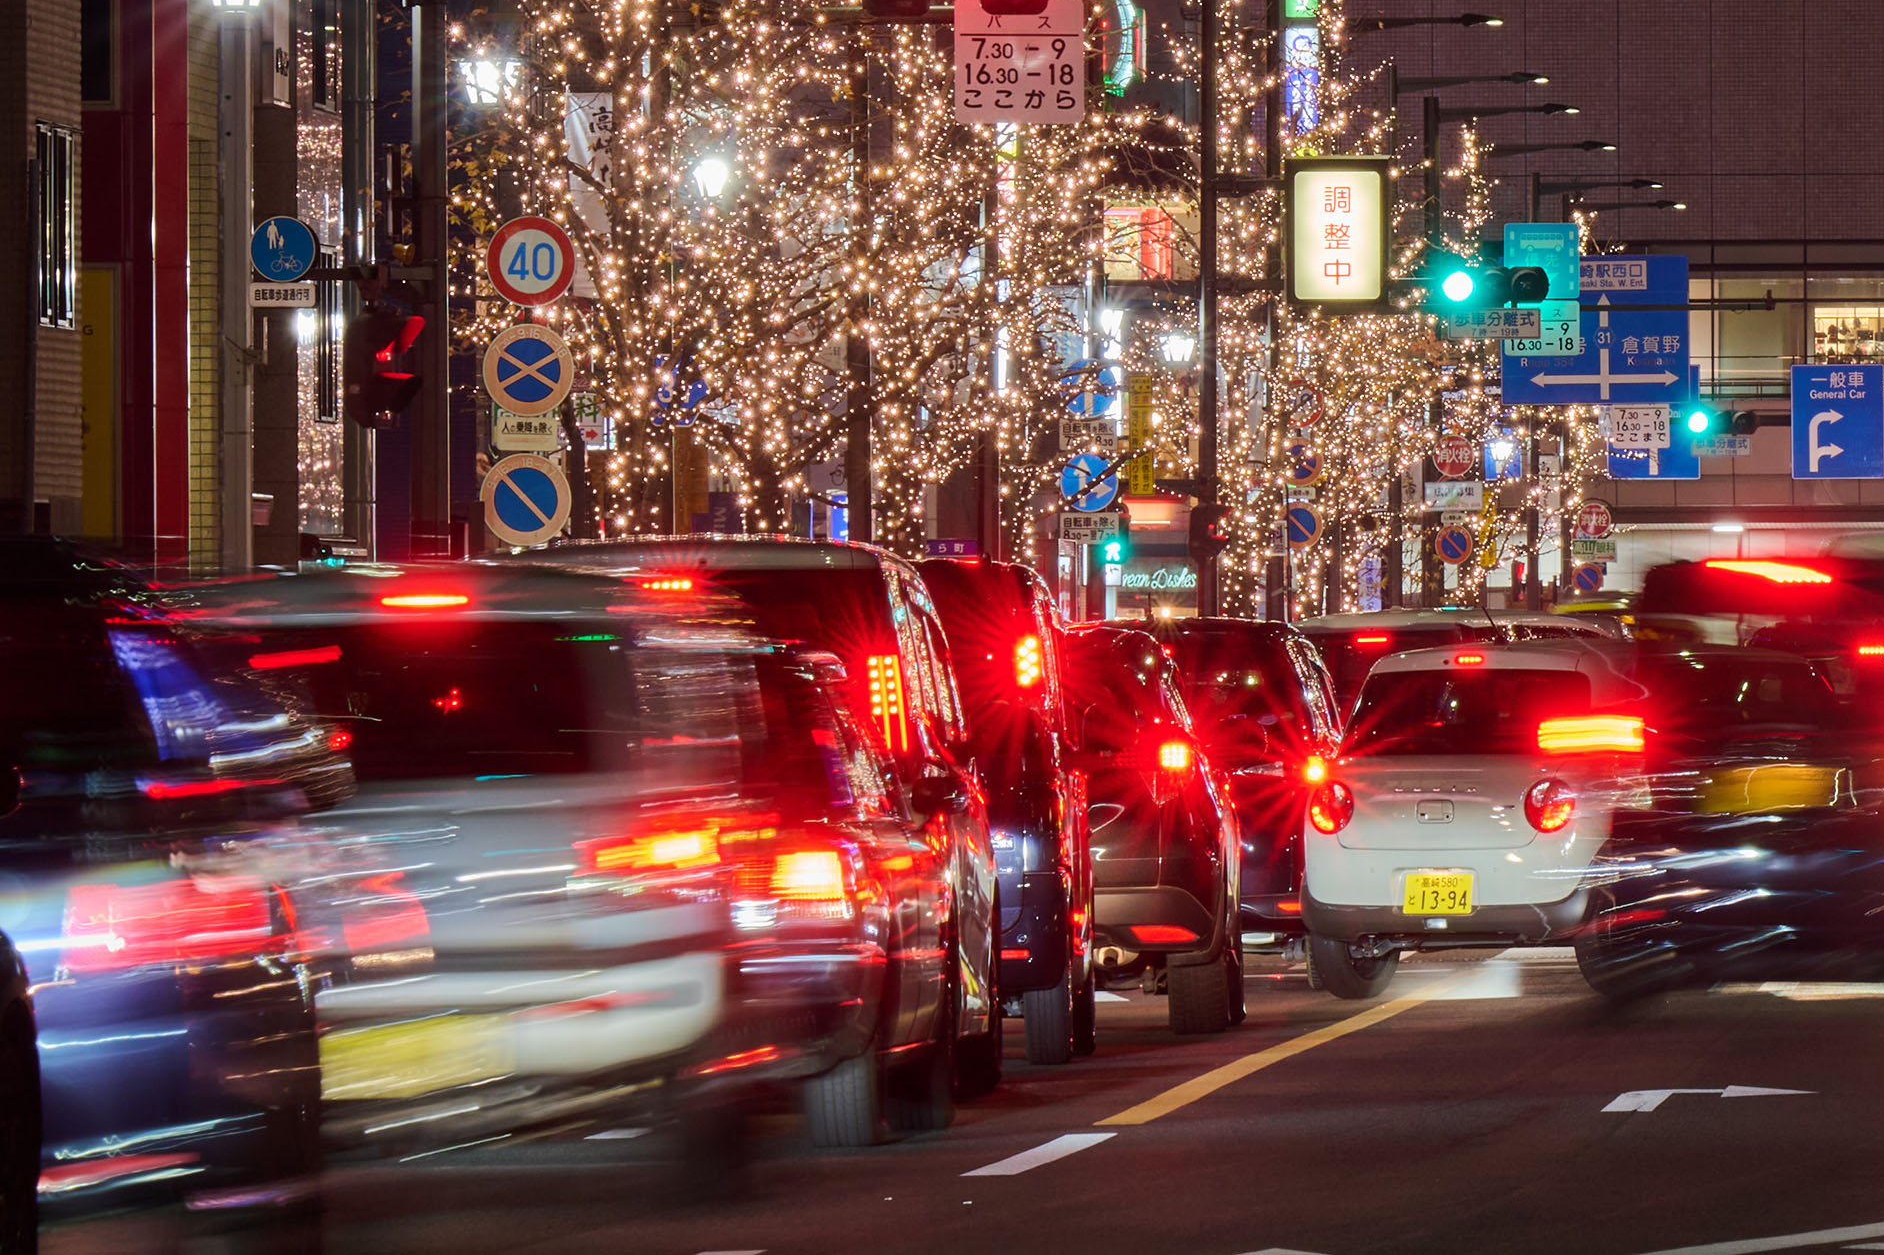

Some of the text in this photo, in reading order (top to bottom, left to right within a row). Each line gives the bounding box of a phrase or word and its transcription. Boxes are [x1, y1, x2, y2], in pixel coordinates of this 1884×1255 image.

[972, 38, 1013, 59] 7.30
[965, 63, 1018, 85] 16.30
[1049, 63, 1074, 85] 18
[964, 89, 1076, 109] ここから
[1324, 186, 1351, 285] 調整中
[508, 242, 554, 281] 40
[1600, 279, 1615, 288] Sta.
[1559, 338, 1574, 350] 18
[1597, 333, 1611, 344] 31
[1622, 335, 1681, 355] 倉賀野
[1811, 371, 1864, 388] 一般車
[1809, 389, 1866, 399] General Car
[1619, 410, 1638, 420] 7.30
[1616, 432, 1666, 442] ここまで
[1063, 516, 1115, 528] 自転車を除く
[1152, 567, 1196, 589] Dishes
[1421, 890, 1467, 910] 13-94
